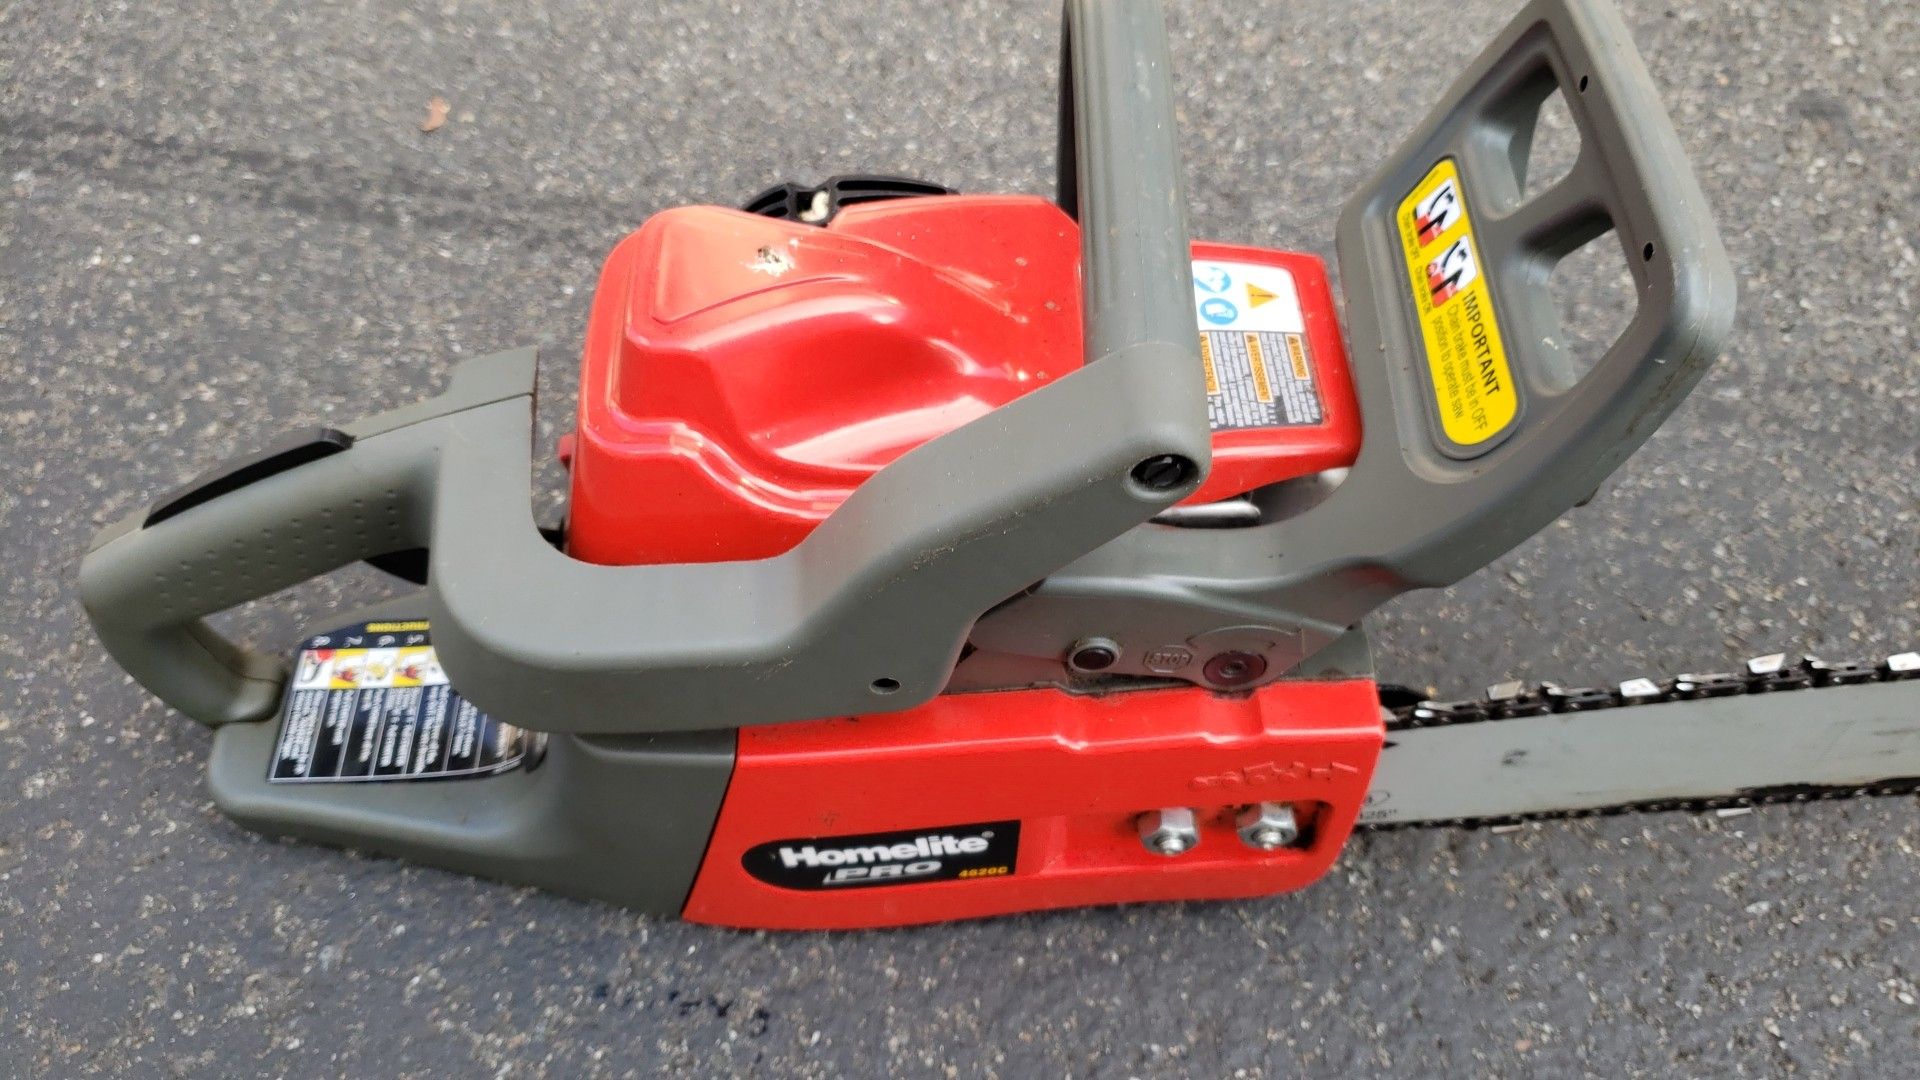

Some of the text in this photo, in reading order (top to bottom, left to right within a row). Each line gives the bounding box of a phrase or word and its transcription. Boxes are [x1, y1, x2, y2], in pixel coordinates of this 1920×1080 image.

[1432, 315, 1449, 350] position
[1463, 290, 1500, 396] IMPORTANT
[1440, 349, 1452, 362] to
[1447, 304, 1488, 431] Chain brake must be in OFF
[1442, 362, 1460, 398] operate
[779, 834, 989, 868] Homelite
[829, 860, 942, 882] PRO
